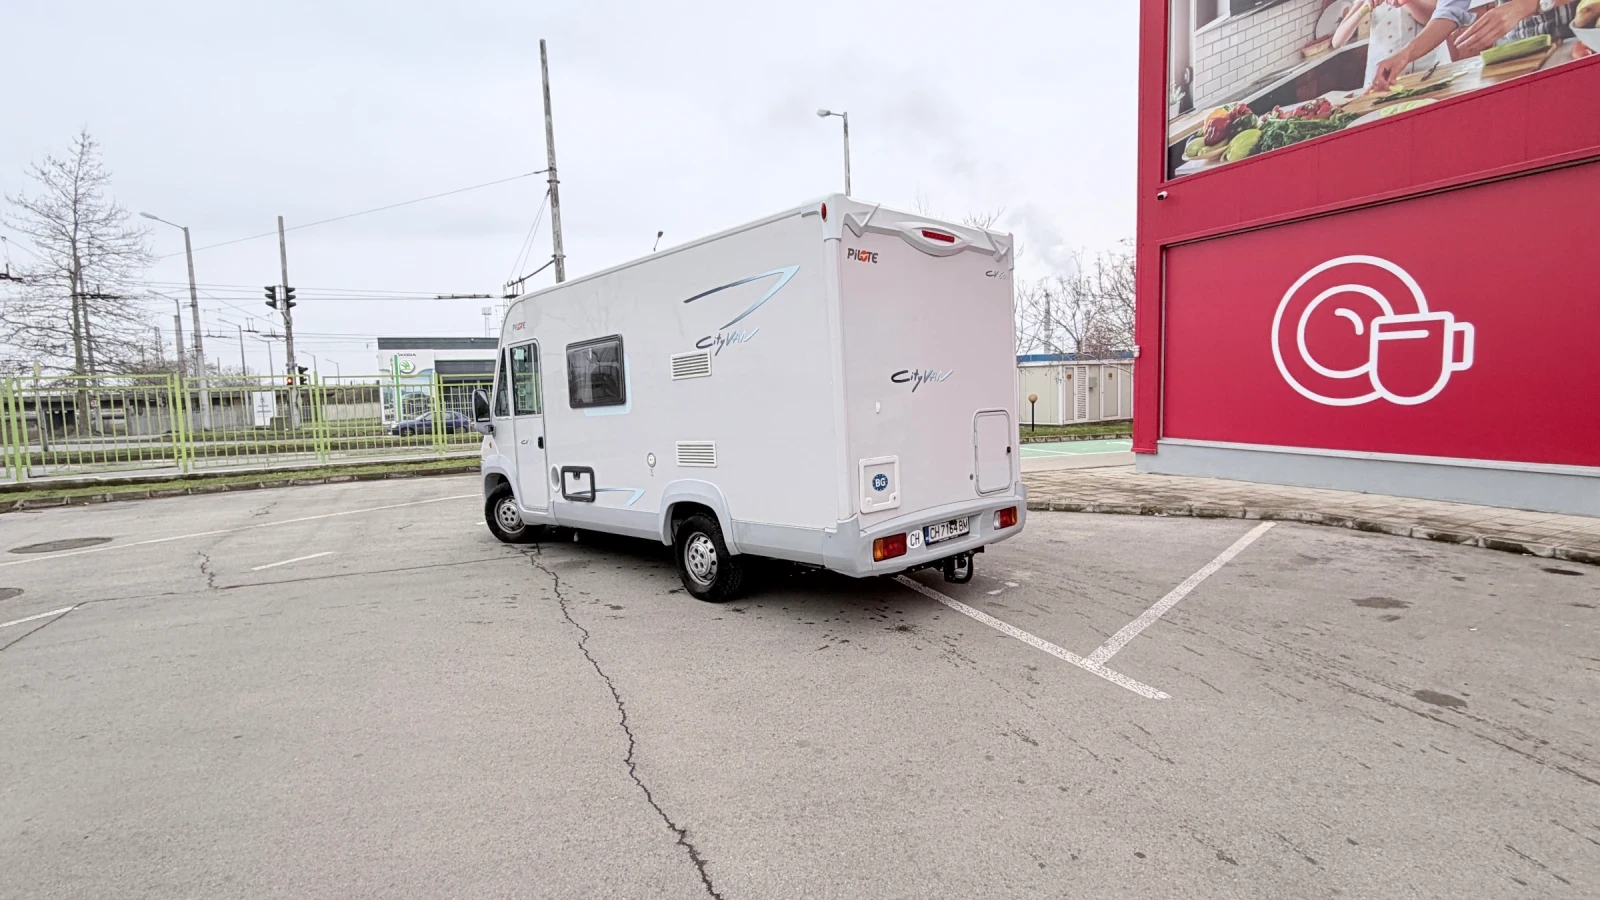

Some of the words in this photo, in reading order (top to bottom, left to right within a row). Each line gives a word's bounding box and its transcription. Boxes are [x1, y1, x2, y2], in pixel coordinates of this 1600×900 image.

[875, 477, 886, 488] BG
[910, 532, 920, 547] CH
[930, 525, 940, 540] CH
